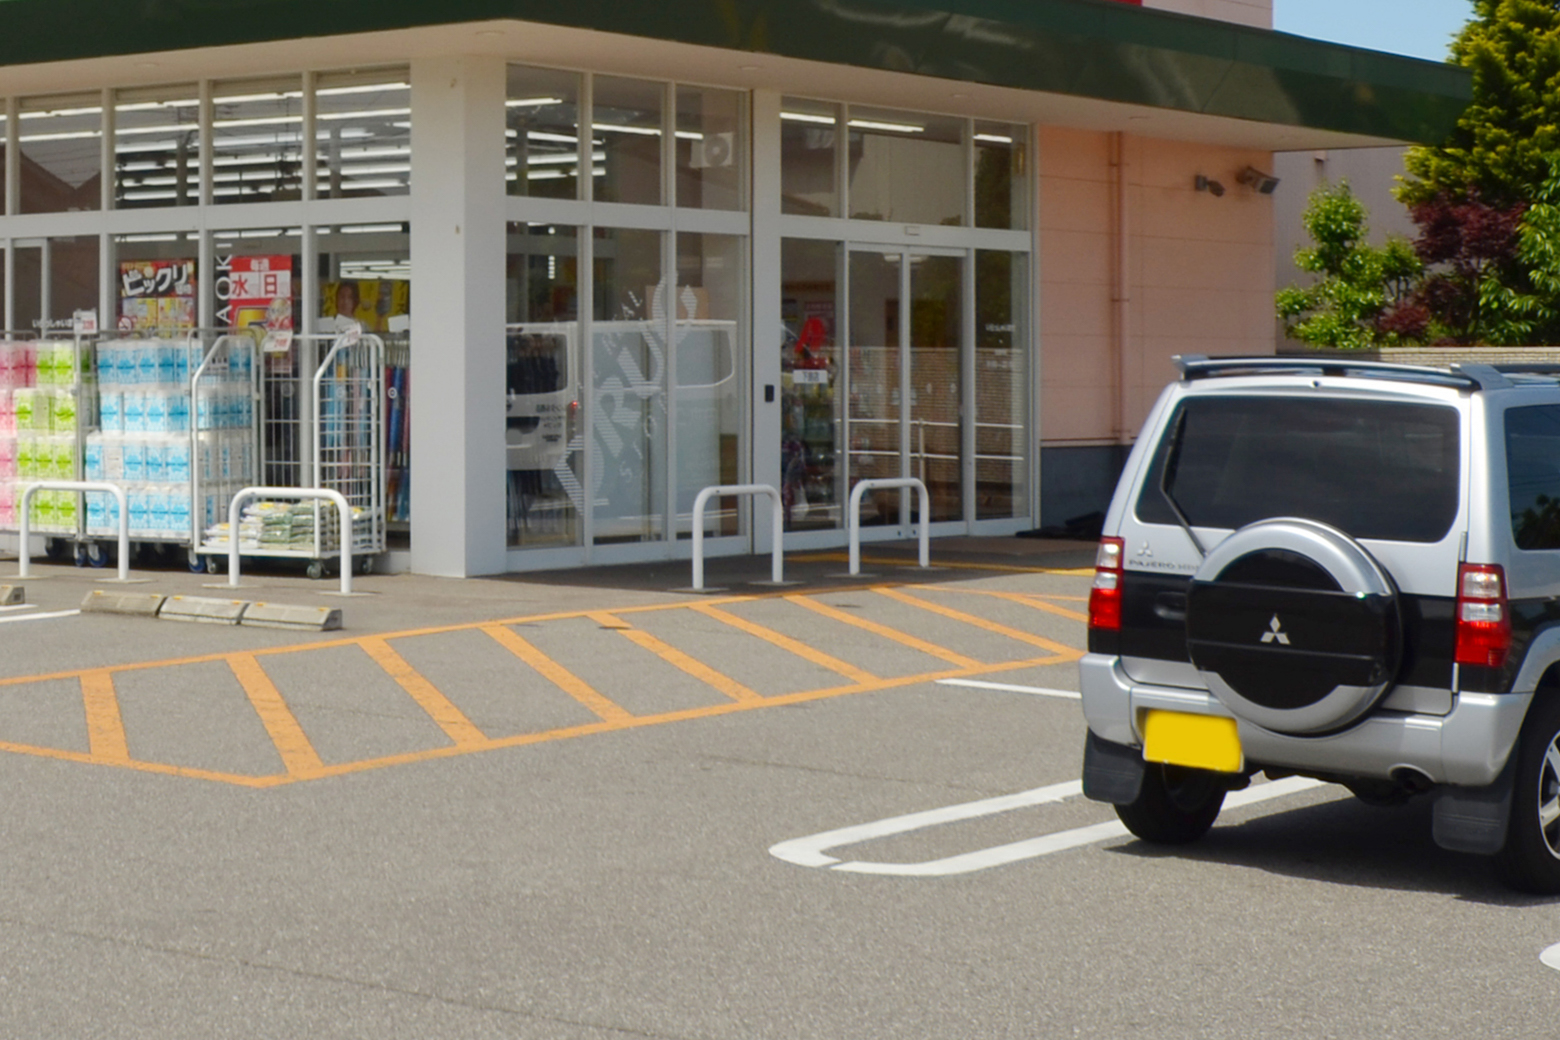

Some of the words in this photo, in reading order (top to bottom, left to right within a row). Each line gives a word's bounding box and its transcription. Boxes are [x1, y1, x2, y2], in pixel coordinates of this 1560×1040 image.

[122, 264, 188, 296] ビックリ
[215, 243, 233, 324] AOKI
[1129, 559, 1175, 569] PAJERO
